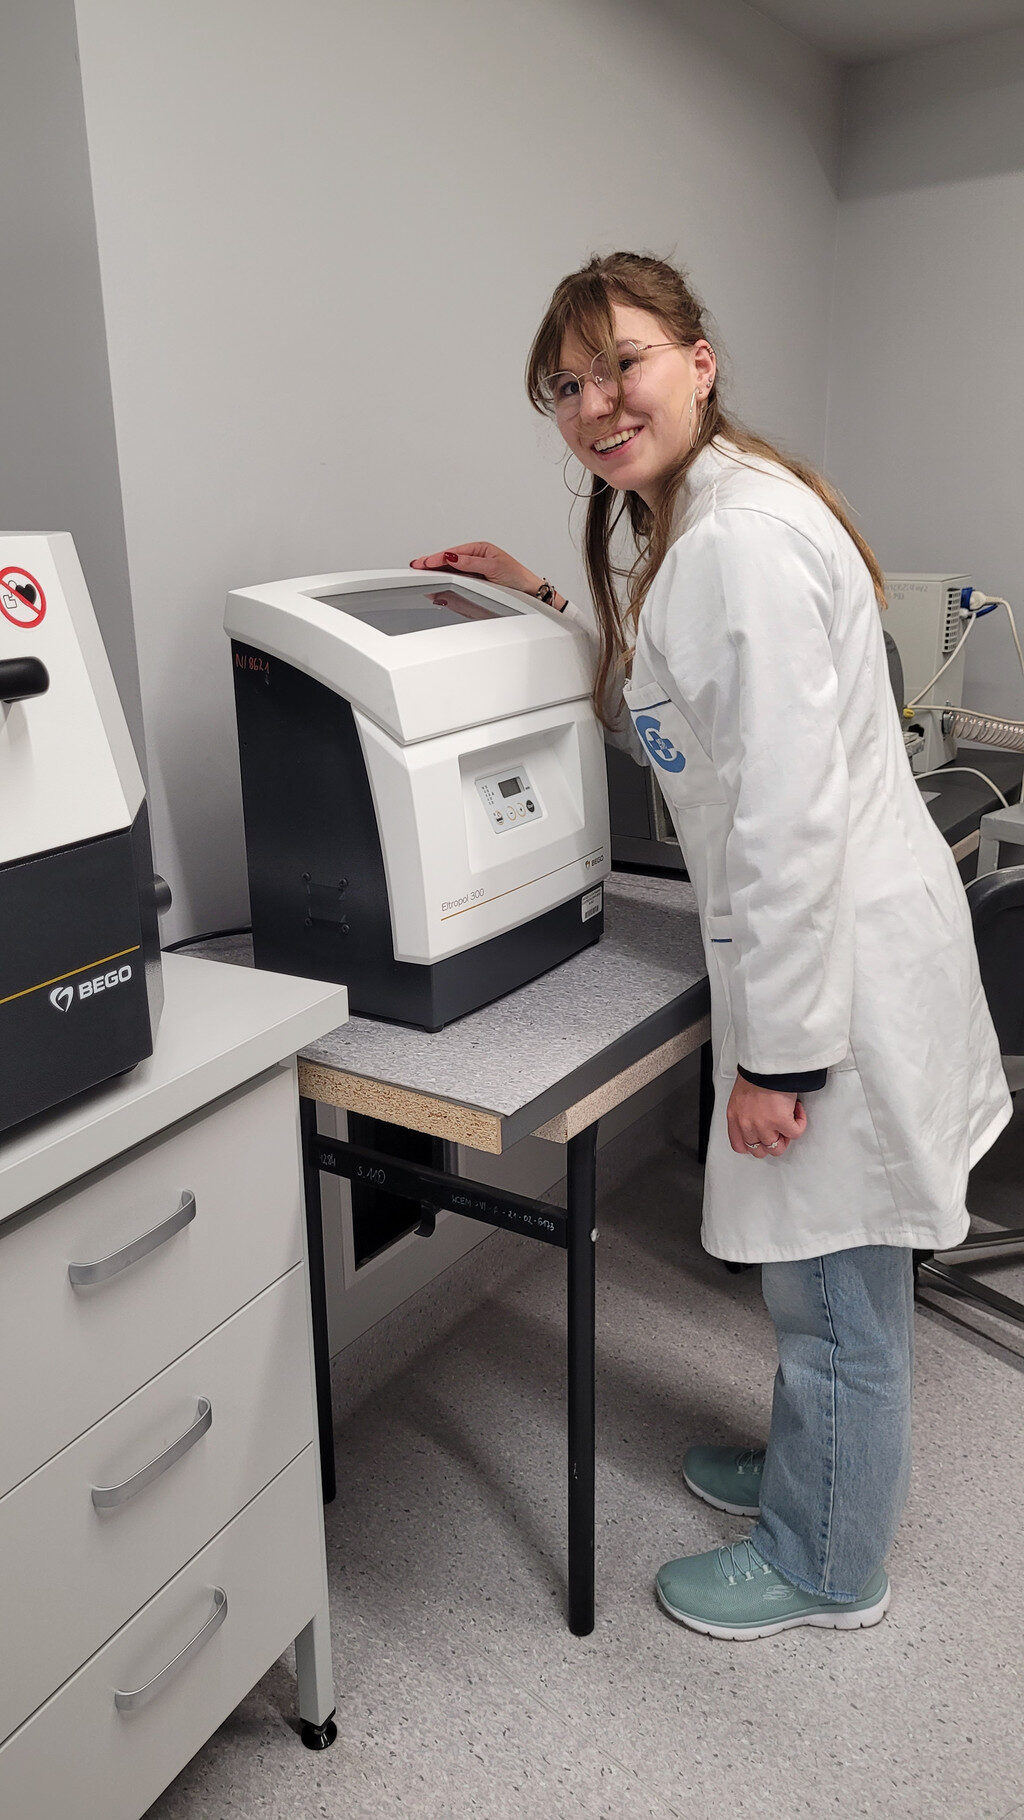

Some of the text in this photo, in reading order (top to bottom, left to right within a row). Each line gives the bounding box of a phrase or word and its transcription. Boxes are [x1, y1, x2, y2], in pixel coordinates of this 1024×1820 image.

[591, 854, 604, 867] BEGO
[441, 888, 485, 912] Eltropol 300
[78, 965, 133, 1000] BEGO
